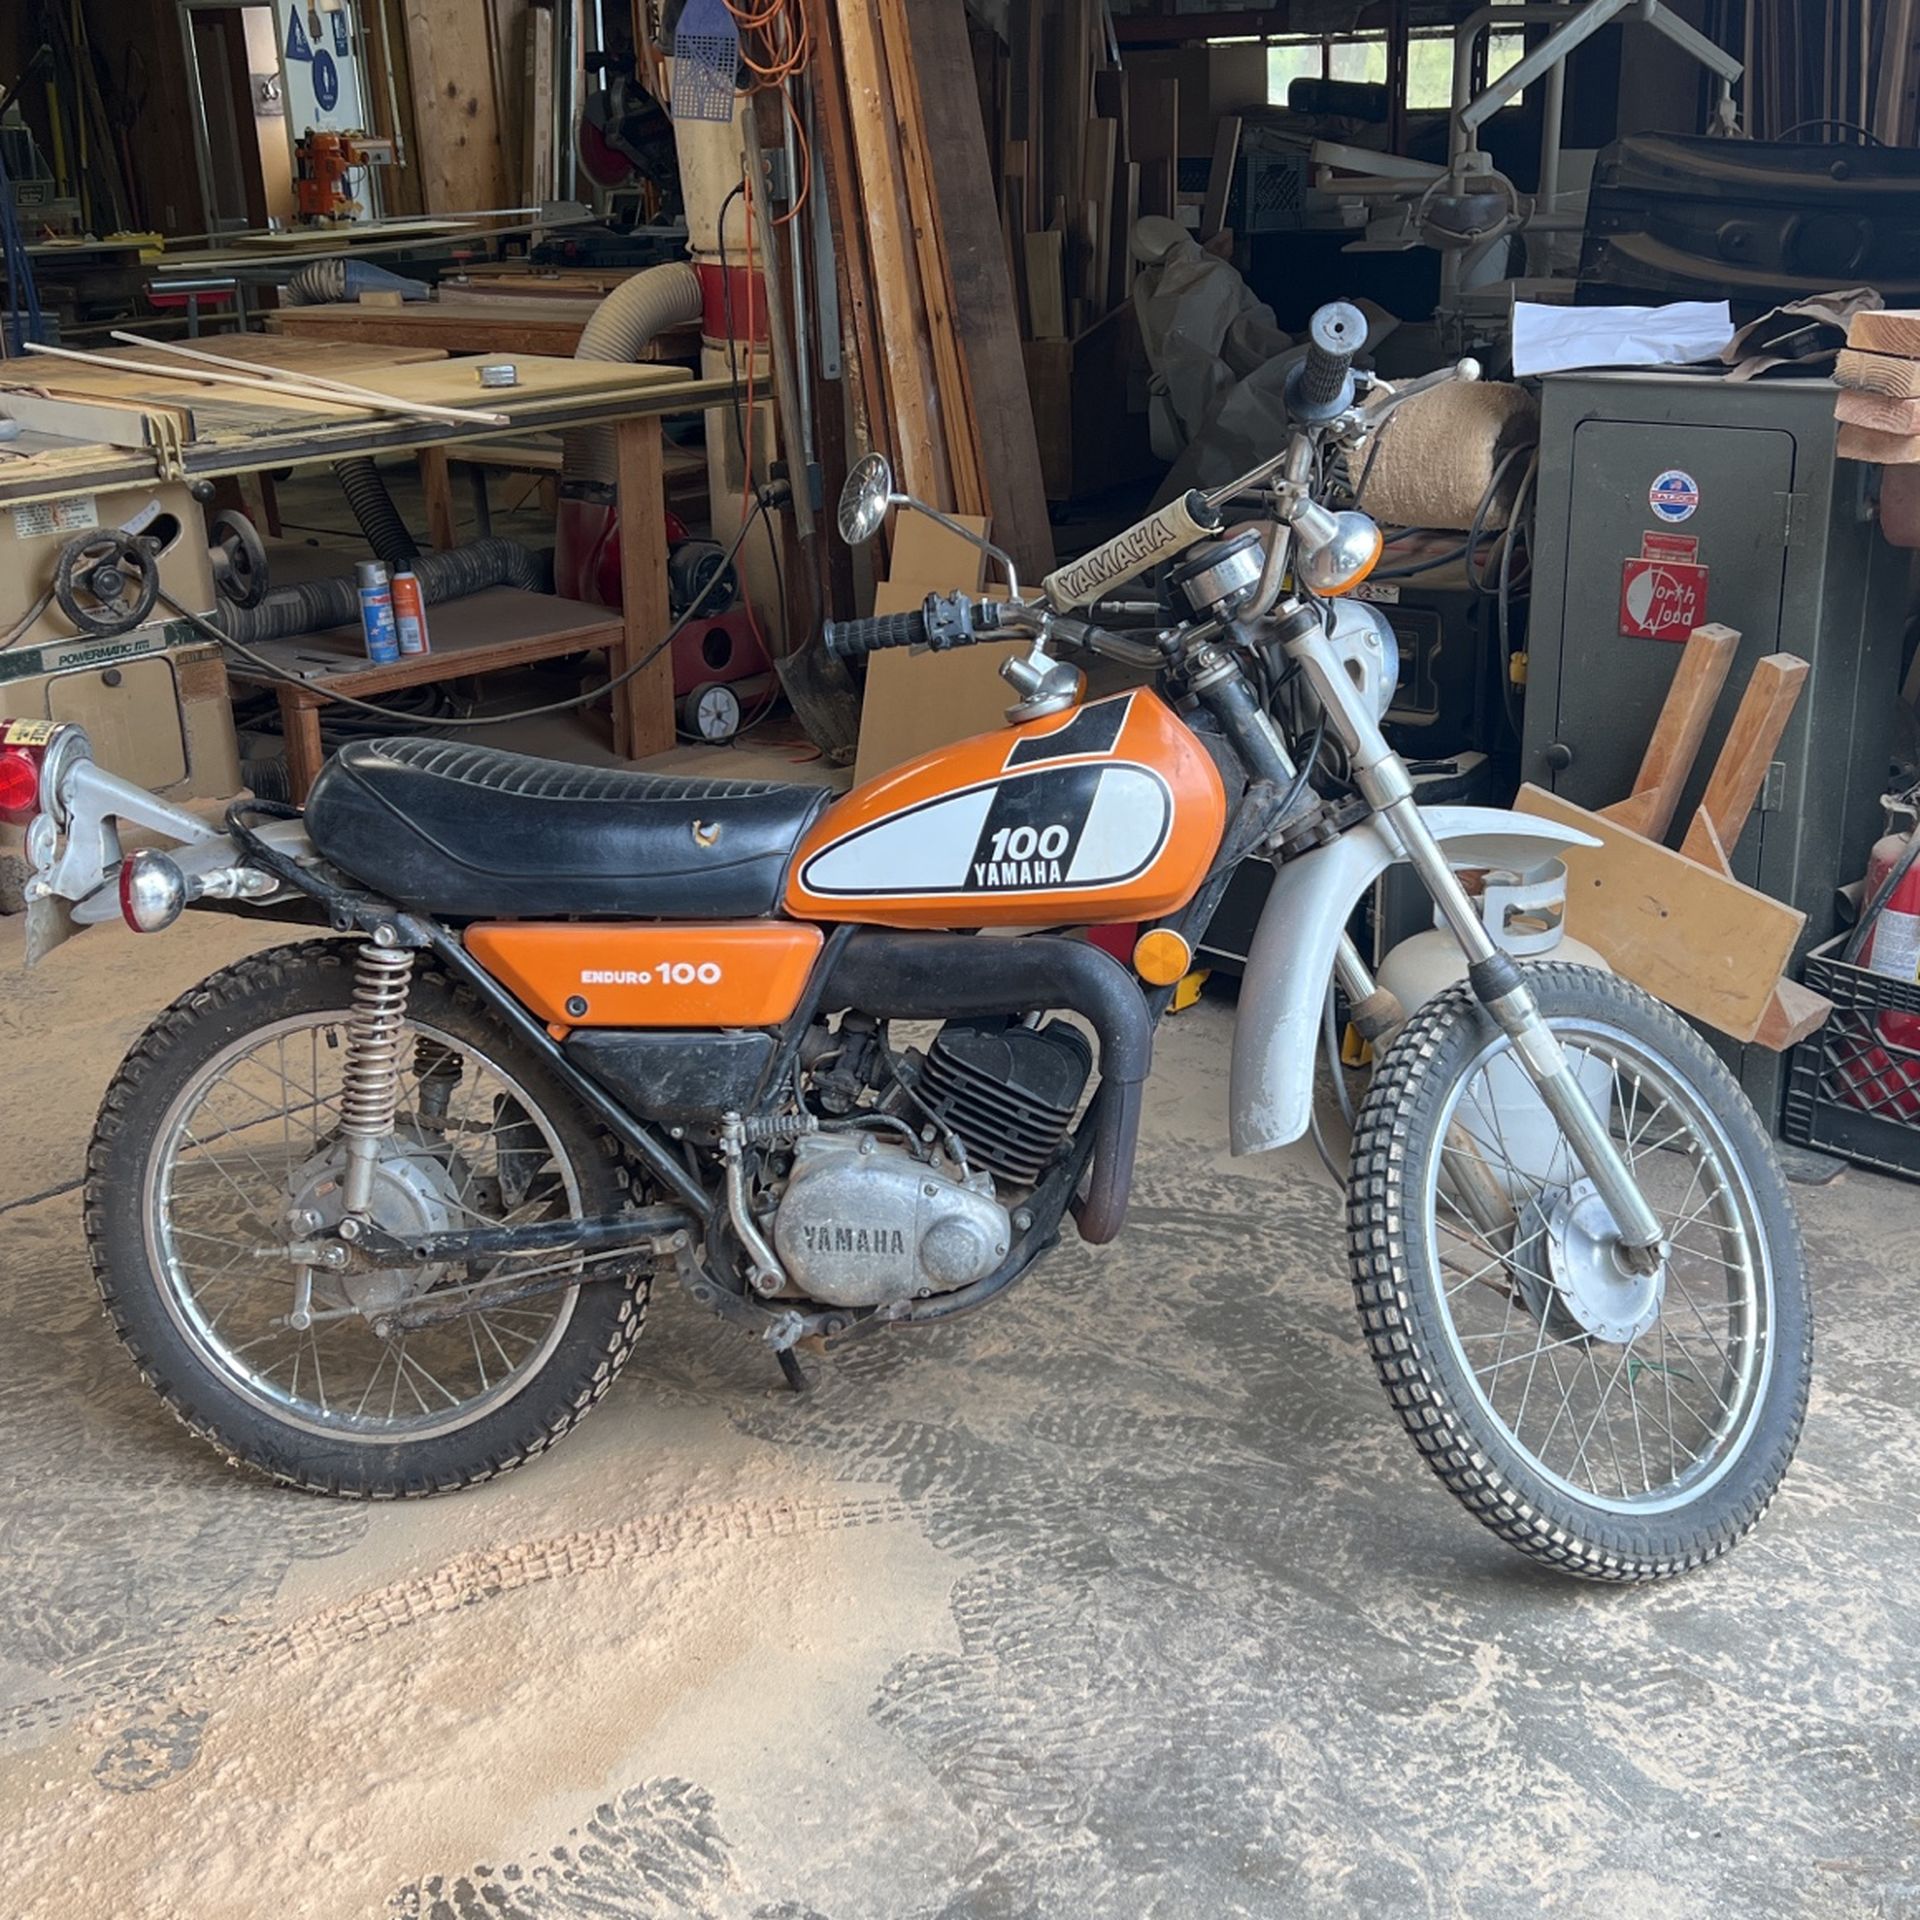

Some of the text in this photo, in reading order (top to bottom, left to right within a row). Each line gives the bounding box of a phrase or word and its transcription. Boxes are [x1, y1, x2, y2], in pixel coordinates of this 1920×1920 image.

[1058, 518, 1176, 598] YAMAHA
[59, 645, 132, 666] POWERMATIC
[991, 824, 1070, 861] 100
[974, 860, 1062, 886] YAMAHA
[581, 962, 721, 985] ENDURO 100
[804, 1226, 904, 1254] YAMAHA
